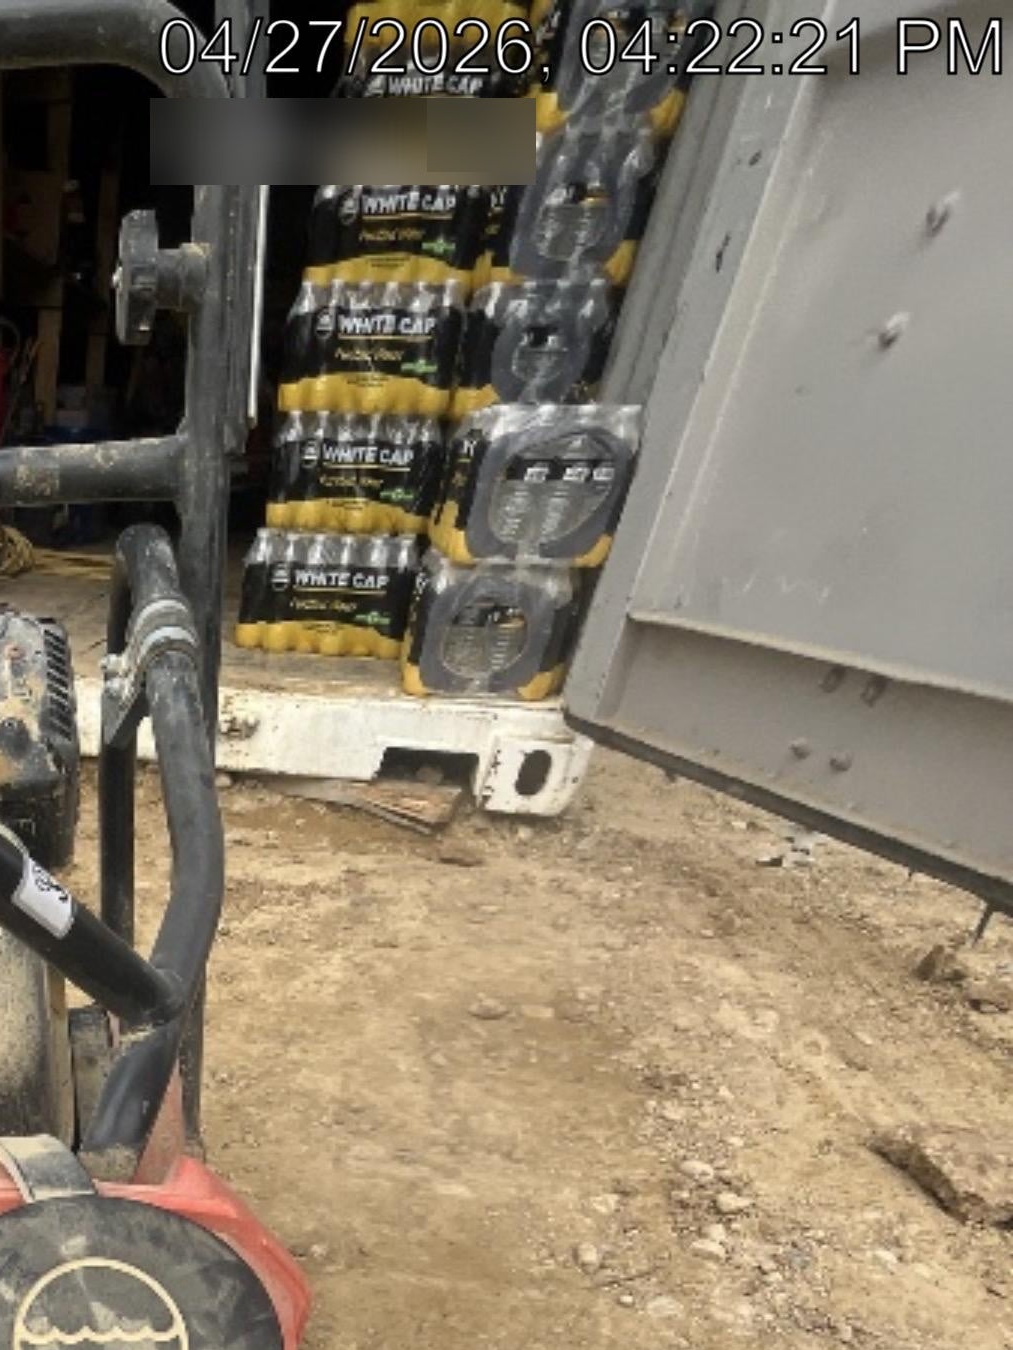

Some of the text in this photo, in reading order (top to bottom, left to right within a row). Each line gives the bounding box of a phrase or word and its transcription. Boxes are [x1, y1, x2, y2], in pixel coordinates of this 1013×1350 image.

[362, 191, 456, 213] WHITE CAP
[339, 314, 436, 334] WHITE CAP
[322, 444, 415, 465] WHITE CAP
[294, 569, 389, 588] WHITE CAP
